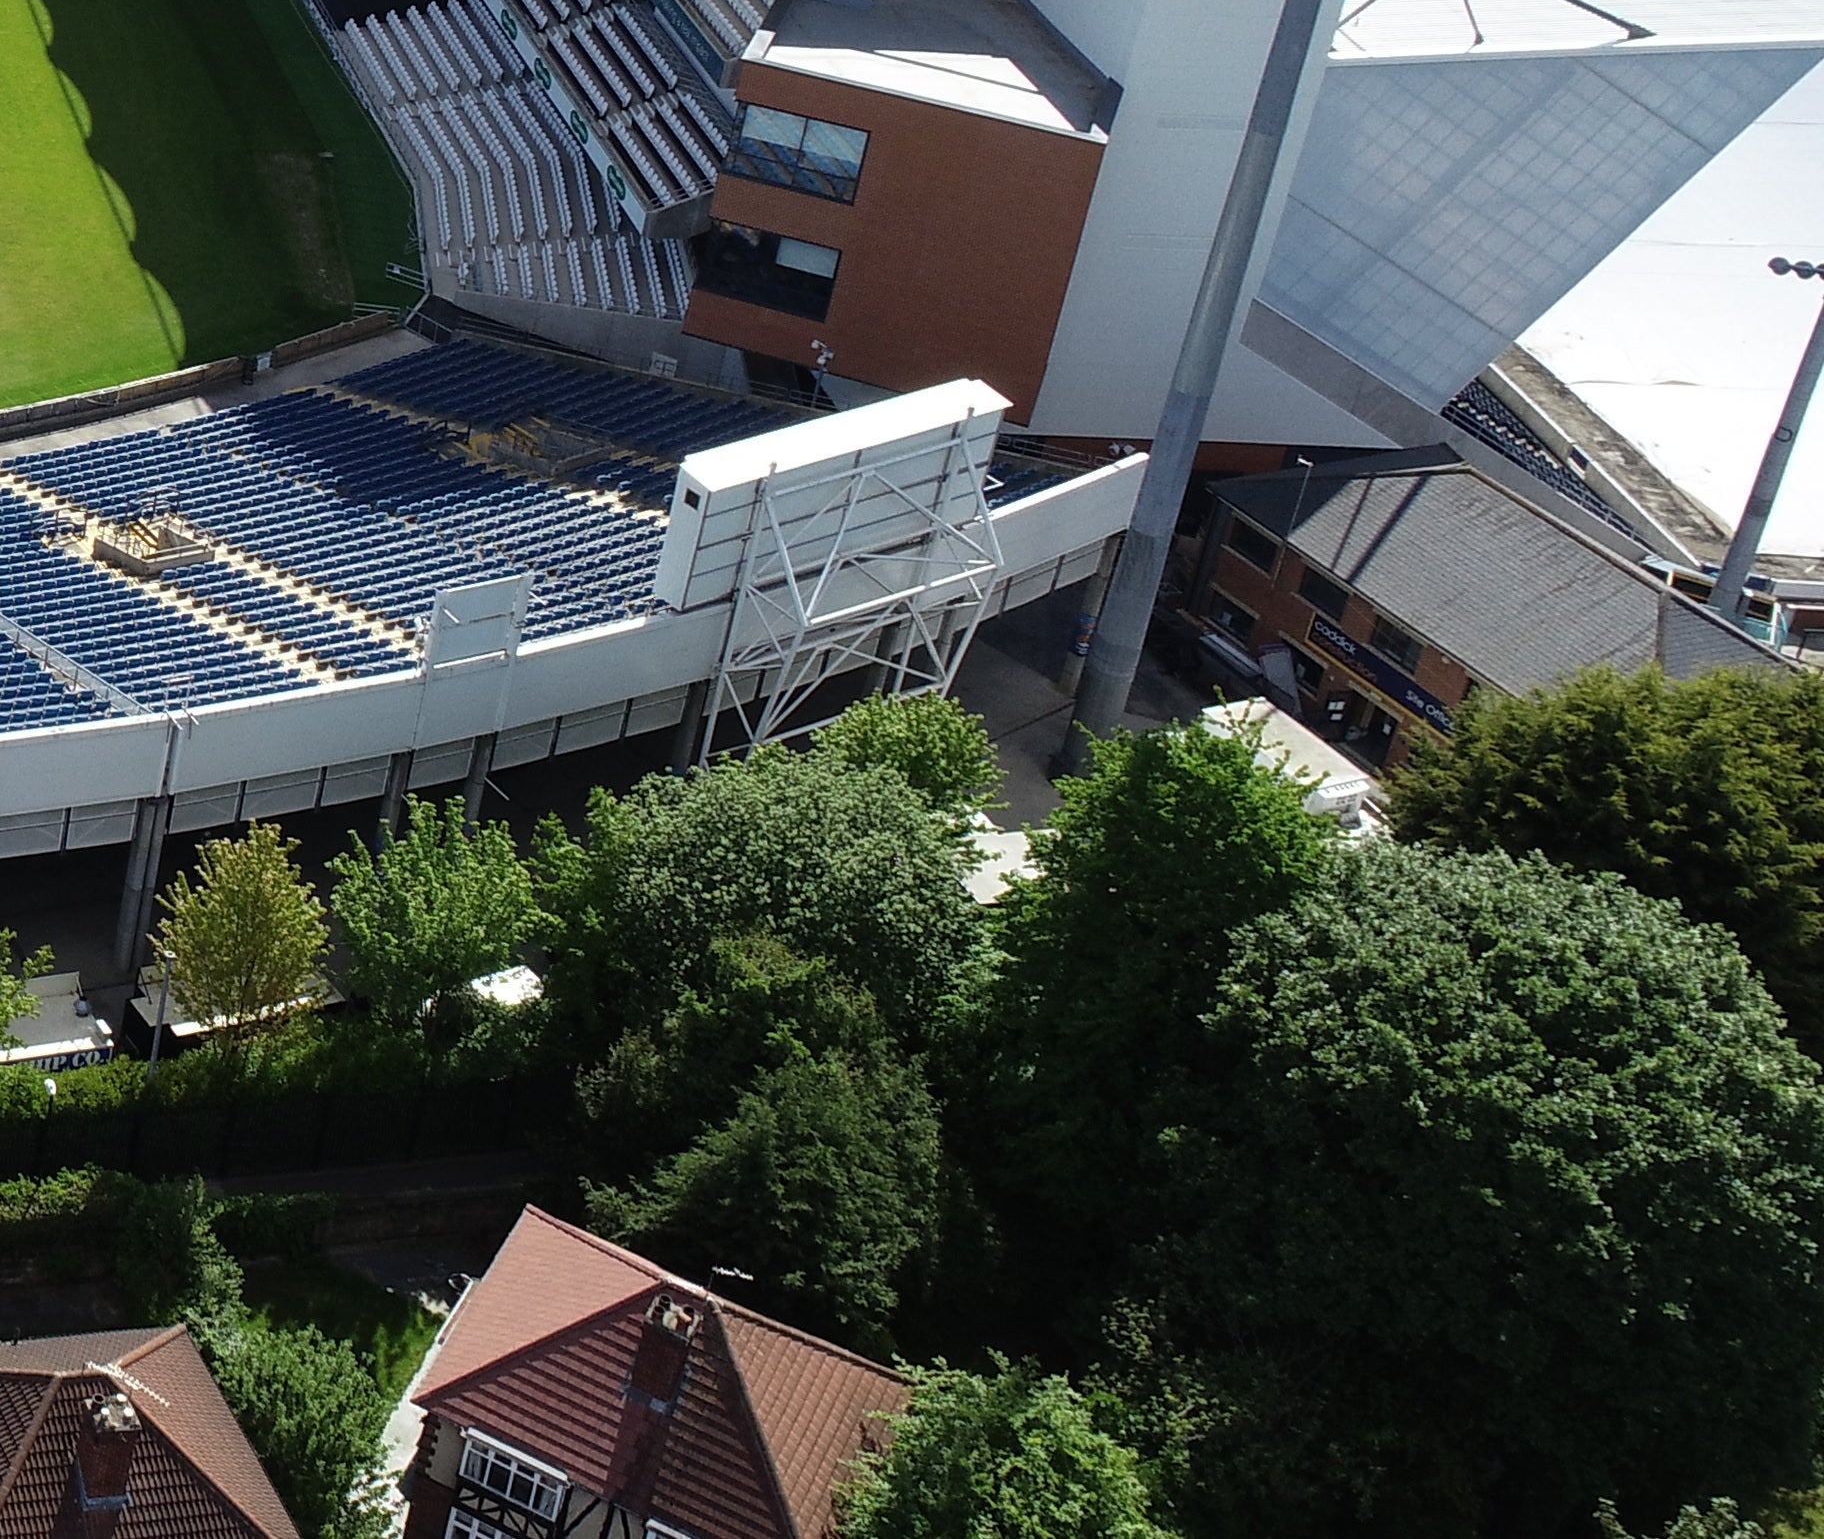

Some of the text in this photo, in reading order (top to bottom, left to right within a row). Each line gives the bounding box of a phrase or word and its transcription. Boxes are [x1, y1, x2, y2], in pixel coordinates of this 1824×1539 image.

[1314, 621, 1356, 654] caddick
[1405, 689, 1424, 709] Site
[32, 1051, 104, 1072] HIP CO.
